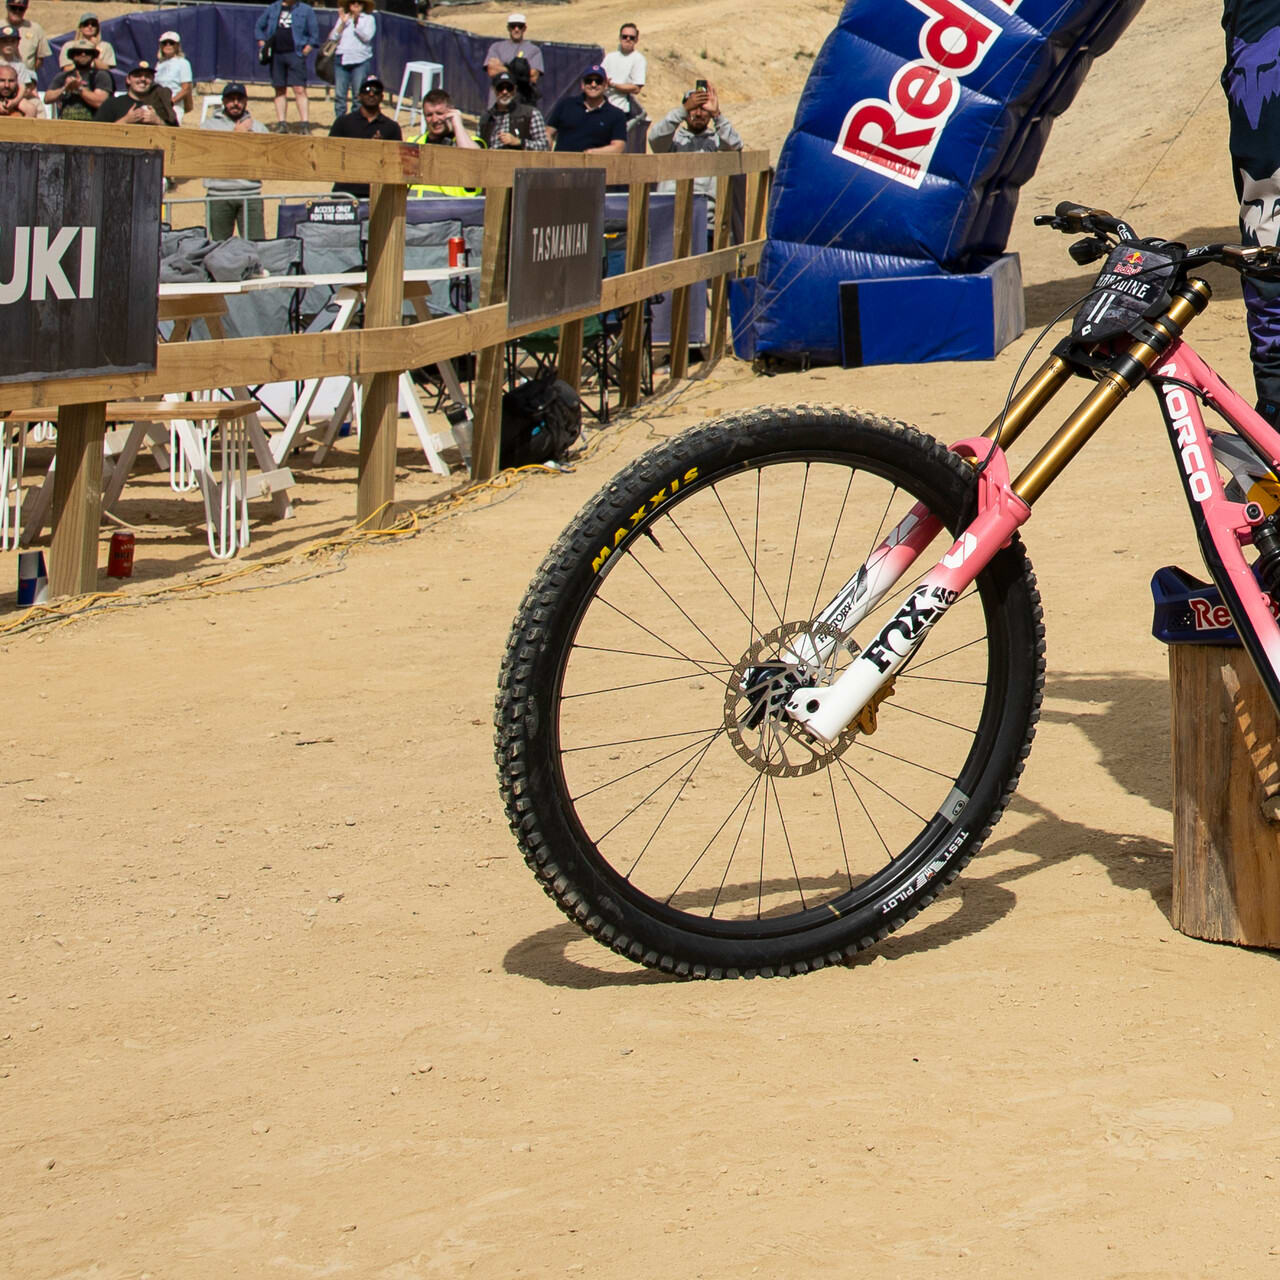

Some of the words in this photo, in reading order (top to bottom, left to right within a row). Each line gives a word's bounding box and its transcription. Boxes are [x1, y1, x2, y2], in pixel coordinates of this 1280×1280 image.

[532, 223, 588, 263] TASMANIAN
[1158, 363, 1213, 503] NORCO
[592, 466, 699, 574] MAXXIS
[817, 602, 853, 644] FATORY
[1188, 598, 1233, 630] Re
[861, 596, 936, 674] FOX
[944, 831, 969, 861] TEST
[882, 885, 915, 914] PILOT
